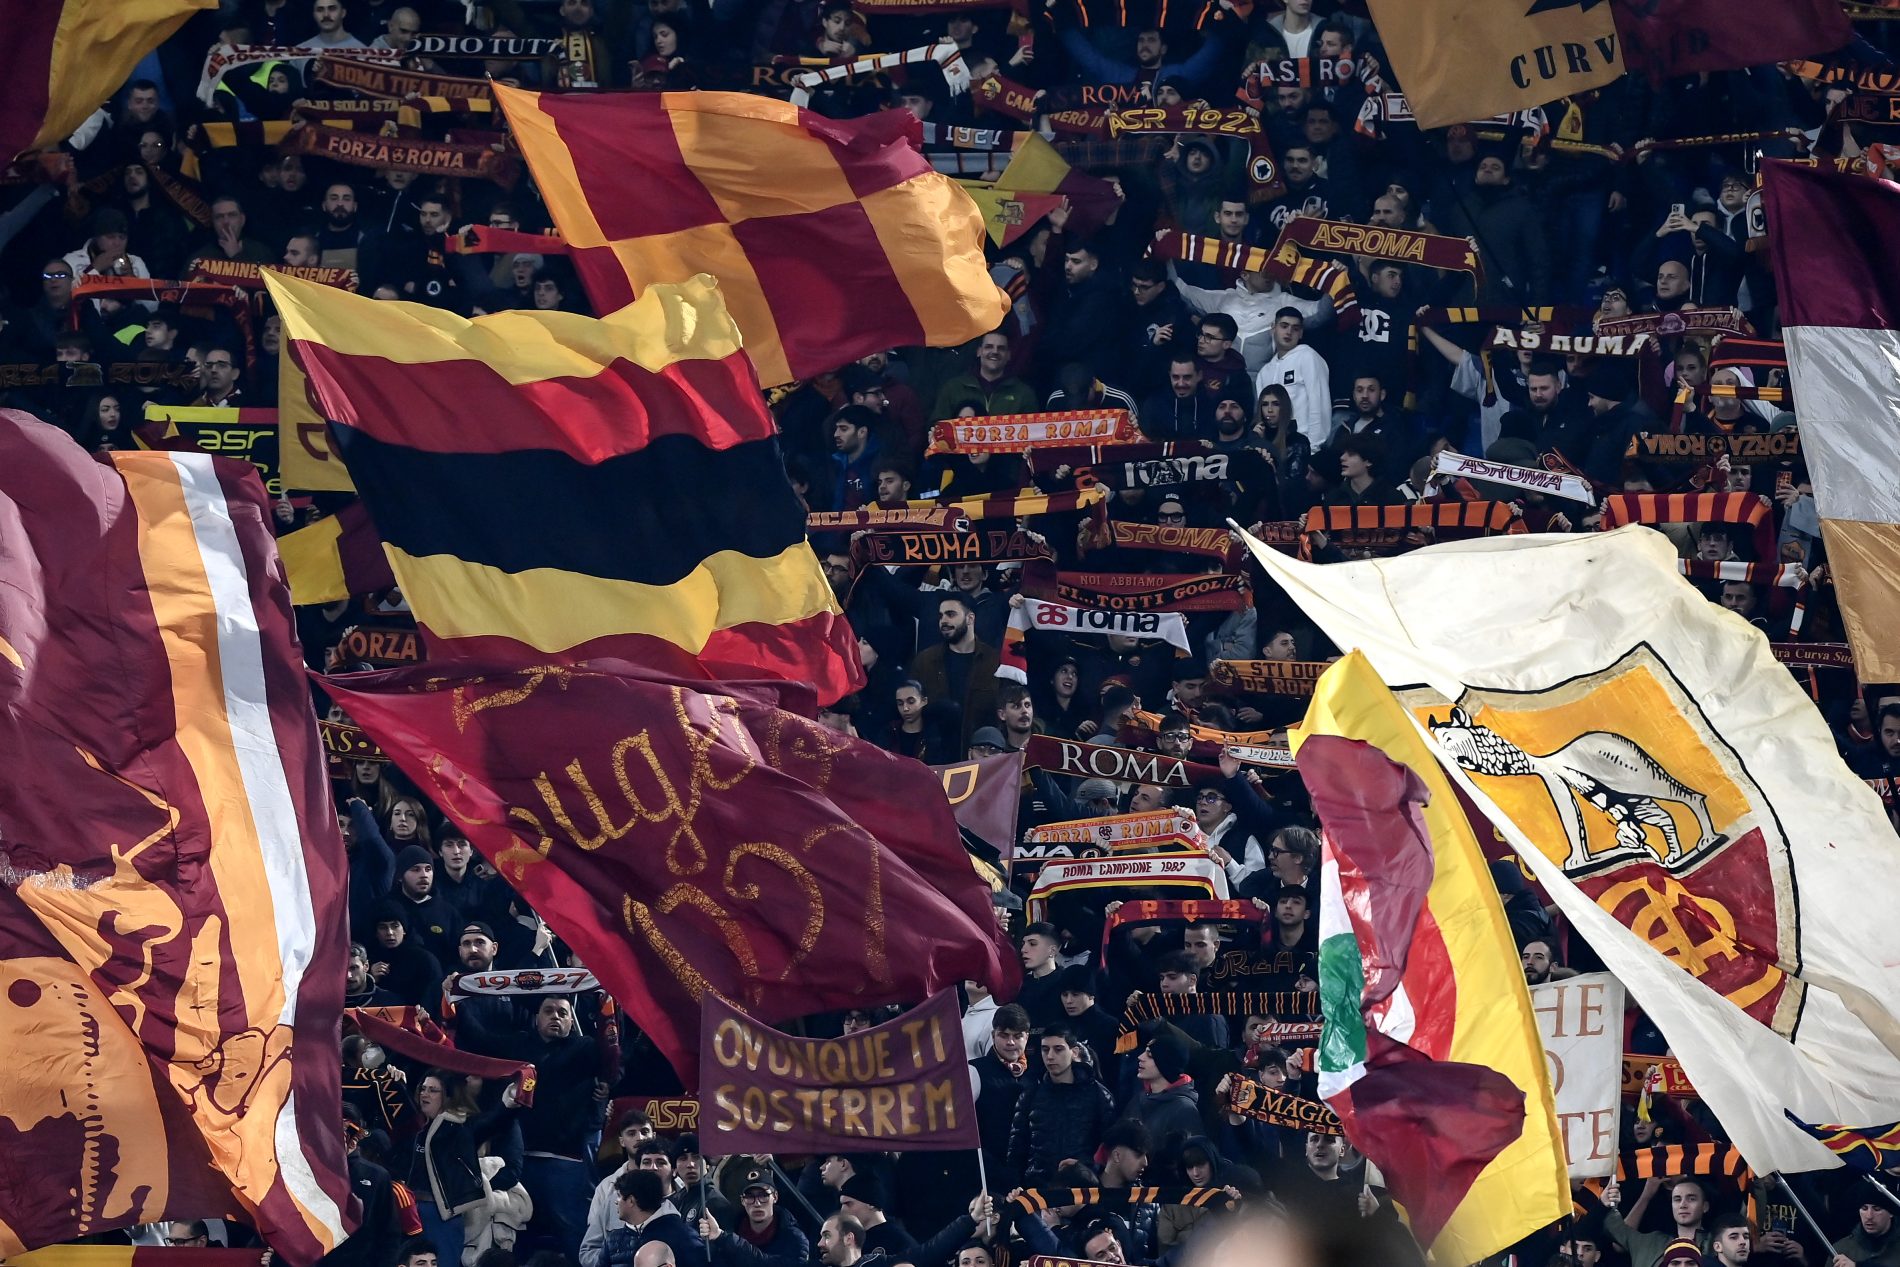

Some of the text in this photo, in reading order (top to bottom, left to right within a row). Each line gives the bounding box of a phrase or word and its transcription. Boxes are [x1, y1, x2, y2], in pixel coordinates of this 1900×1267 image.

[1511, 34, 1617, 89] CURV
[333, 63, 386, 90] ROMA
[327, 137, 464, 169] FORZA ROMA
[1310, 223, 1427, 261] ASROMA
[196, 429, 275, 450] asr
[963, 419, 1108, 442] FORZA ROMA
[1644, 433, 1800, 456] FORZA ROMA
[866, 508, 949, 527] ROMA
[901, 532, 981, 561] ROMA
[1080, 575, 1164, 588] NOI ABBIAMO
[1097, 594, 1165, 610] TOTTI
[1076, 609, 1160, 633] roma
[350, 630, 418, 661] ORZA
[1795, 649, 1830, 661] Curva
[1250, 661, 1285, 677] STI
[1243, 677, 1315, 696] DE ROM
[1058, 742, 1193, 787] ROMA
[1039, 829, 1092, 843] FORZA
[1121, 819, 1174, 839] ROMA
[1013, 845, 1074, 859] MA
[1063, 864, 1093, 879] ROMA
[1099, 861, 1152, 876] CAMPIONE
[474, 971, 589, 990] 19 27
[713, 1016, 946, 1083] OVUNQUE TI
[714, 1079, 957, 1137] SOSTERREM
